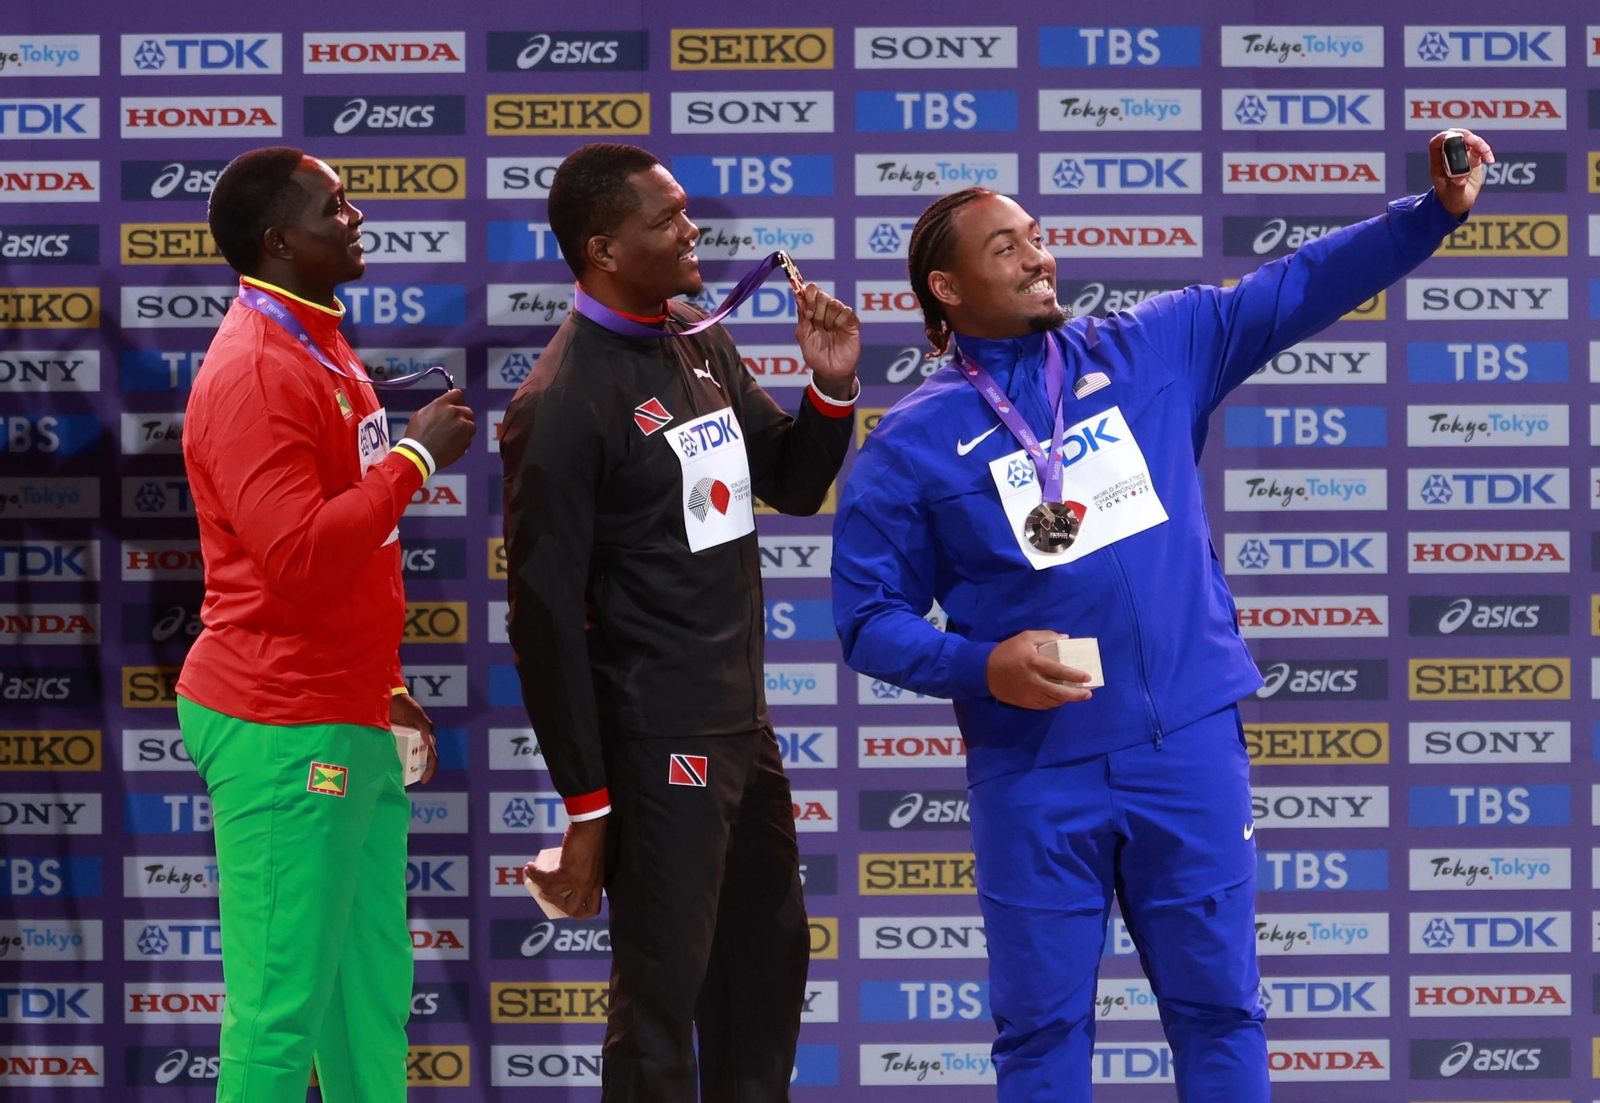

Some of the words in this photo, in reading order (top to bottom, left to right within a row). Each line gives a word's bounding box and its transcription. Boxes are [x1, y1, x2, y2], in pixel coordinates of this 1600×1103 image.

[19, 44, 80, 67] Tokyo
[166, 40, 270, 70] TDK
[310, 44, 460, 62] HONDA
[550, 39, 618, 62] asics
[679, 36, 826, 64] SEIKO
[871, 38, 1001, 59] SONY
[1080, 29, 1160, 65] TBS
[1242, 34, 1302, 62] Tokyo
[1303, 35, 1364, 57] Tokyo
[1450, 32, 1554, 61] TDK
[127, 109, 278, 127] HONDA
[367, 104, 436, 127] asics
[495, 101, 643, 130] SEIKO
[687, 102, 817, 124] SONY
[896, 93, 977, 129] TBS
[1060, 98, 1119, 126] Tokyo
[1120, 98, 1181, 121] Tokyo
[1267, 95, 1371, 124] TDK
[1411, 101, 1561, 119] HONDA
[0, 174, 95, 192] NDA
[341, 166, 460, 195] EIKO
[504, 168, 557, 189] SO
[713, 158, 794, 194] TBS
[877, 162, 936, 190] Tokyo
[937, 163, 998, 185] Tokyo
[1084, 159, 1189, 188] TDK
[1228, 164, 1379, 182] HONDA
[1, 234, 70, 257] asics
[130, 231, 220, 260] SEI
[362, 233, 451, 254] ONY
[753, 227, 814, 250] Tokyo
[1045, 228, 1196, 246] HONDA
[1442, 223, 1561, 252] EIKO
[0, 295, 94, 324] IKO
[138, 298, 230, 319] SON
[346, 288, 427, 324] TBS
[509, 292, 569, 320] Tokyo
[1422, 289, 1552, 311] SONY
[0, 362, 85, 384] ONY
[387, 358, 444, 370] Toky
[1447, 345, 1528, 381] TBS
[0, 418, 61, 454] BS
[365, 415, 388, 450] DK
[690, 413, 739, 452] TDK
[1266, 408, 1347, 444] TBS
[1427, 414, 1487, 442] Tokyo
[1488, 414, 1548, 437] Tokyo
[1026, 417, 1121, 468] DK
[21, 487, 82, 510] Tokyo
[1246, 477, 1305, 505] Tokyo
[1306, 477, 1367, 500] Tokyo
[1452, 475, 1556, 504] TDK
[760, 545, 820, 567] NY
[1270, 538, 1375, 567] TDK
[1413, 544, 1564, 562] HONDA
[0, 617, 97, 635] NDA
[1237, 608, 1382, 626] HONDA
[1470, 604, 1539, 627] asics
[4, 676, 72, 700] asics
[1289, 668, 1357, 691] asics
[1416, 666, 1563, 694] SEIKO
[0, 738, 96, 767] IKO
[140, 740, 191, 762] SO
[864, 736, 965, 754] HON
[1424, 732, 1554, 754] SONY
[0, 805, 87, 827] ONY
[166, 796, 212, 832] TB
[409, 801, 450, 823] kyo
[1449, 788, 1530, 824] TBS
[0, 861, 64, 897] BS
[146, 865, 206, 893] Tokyo
[867, 857, 976, 886] SEIK
[1268, 852, 1349, 888] TBS
[1430, 857, 1489, 885] Tokyo
[1490, 857, 1551, 880] Tokyo
[23, 930, 84, 953] Tokyo
[1309, 921, 1369, 944] Tokyo
[1454, 918, 1558, 947] TDK
[132, 995, 223, 1013] HON
[500, 987, 607, 1016] SEIK
[901, 981, 982, 1017] TBS
[1272, 981, 1377, 1011] TDK
[1415, 987, 1566, 1005] HONDA
[0, 1060, 99, 1078] NDA
[508, 1054, 603, 1075] SON
[881, 1050, 940, 1078] Tokyo
[942, 1050, 993, 1073] Toky
[1267, 1051, 1384, 1069] ONDA
[1472, 1047, 1541, 1070] asics
